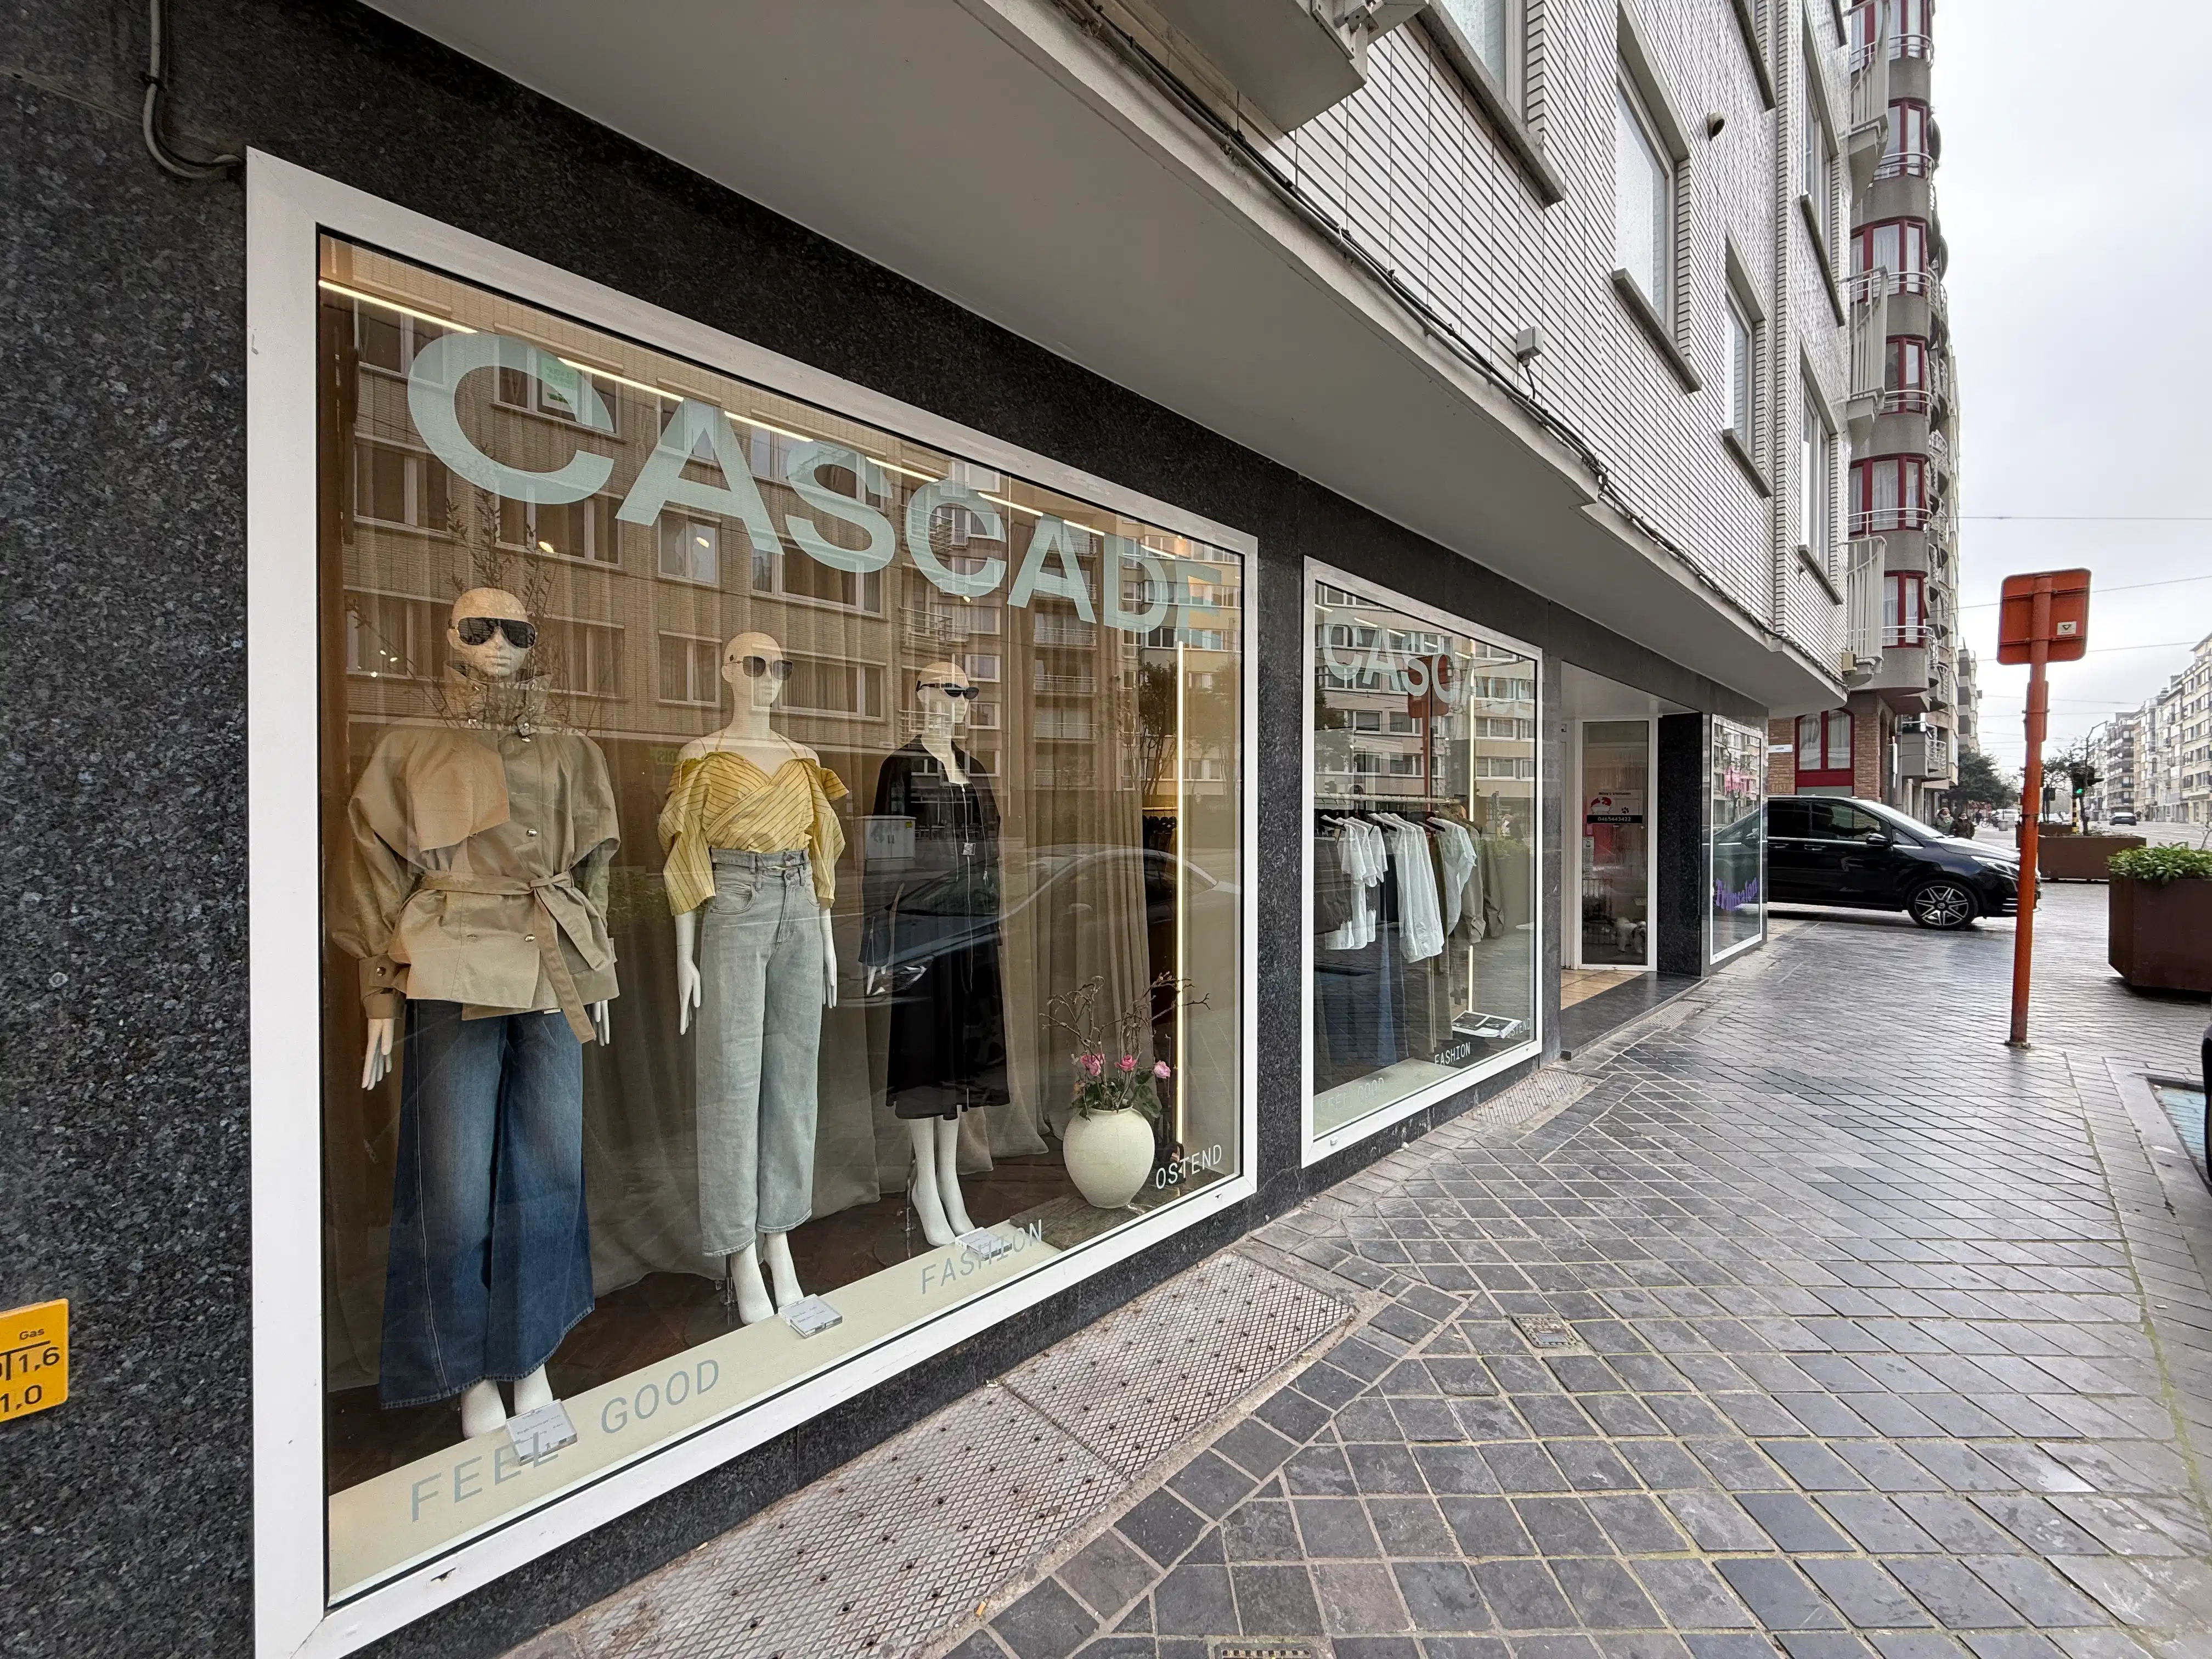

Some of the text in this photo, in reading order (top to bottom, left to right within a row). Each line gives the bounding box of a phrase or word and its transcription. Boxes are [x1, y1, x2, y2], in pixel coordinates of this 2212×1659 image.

[408, 331, 1222, 651] CASCADE
[1434, 1041, 1471, 1066] FASHION
[1156, 1144, 1222, 1189] OSTEND
[922, 1219, 1042, 1295] FASHION
[19, 1328, 44, 1340] Gas
[19, 1346, 60, 1373] 1,6
[412, 1359, 720, 1522] FEEL GOOD
